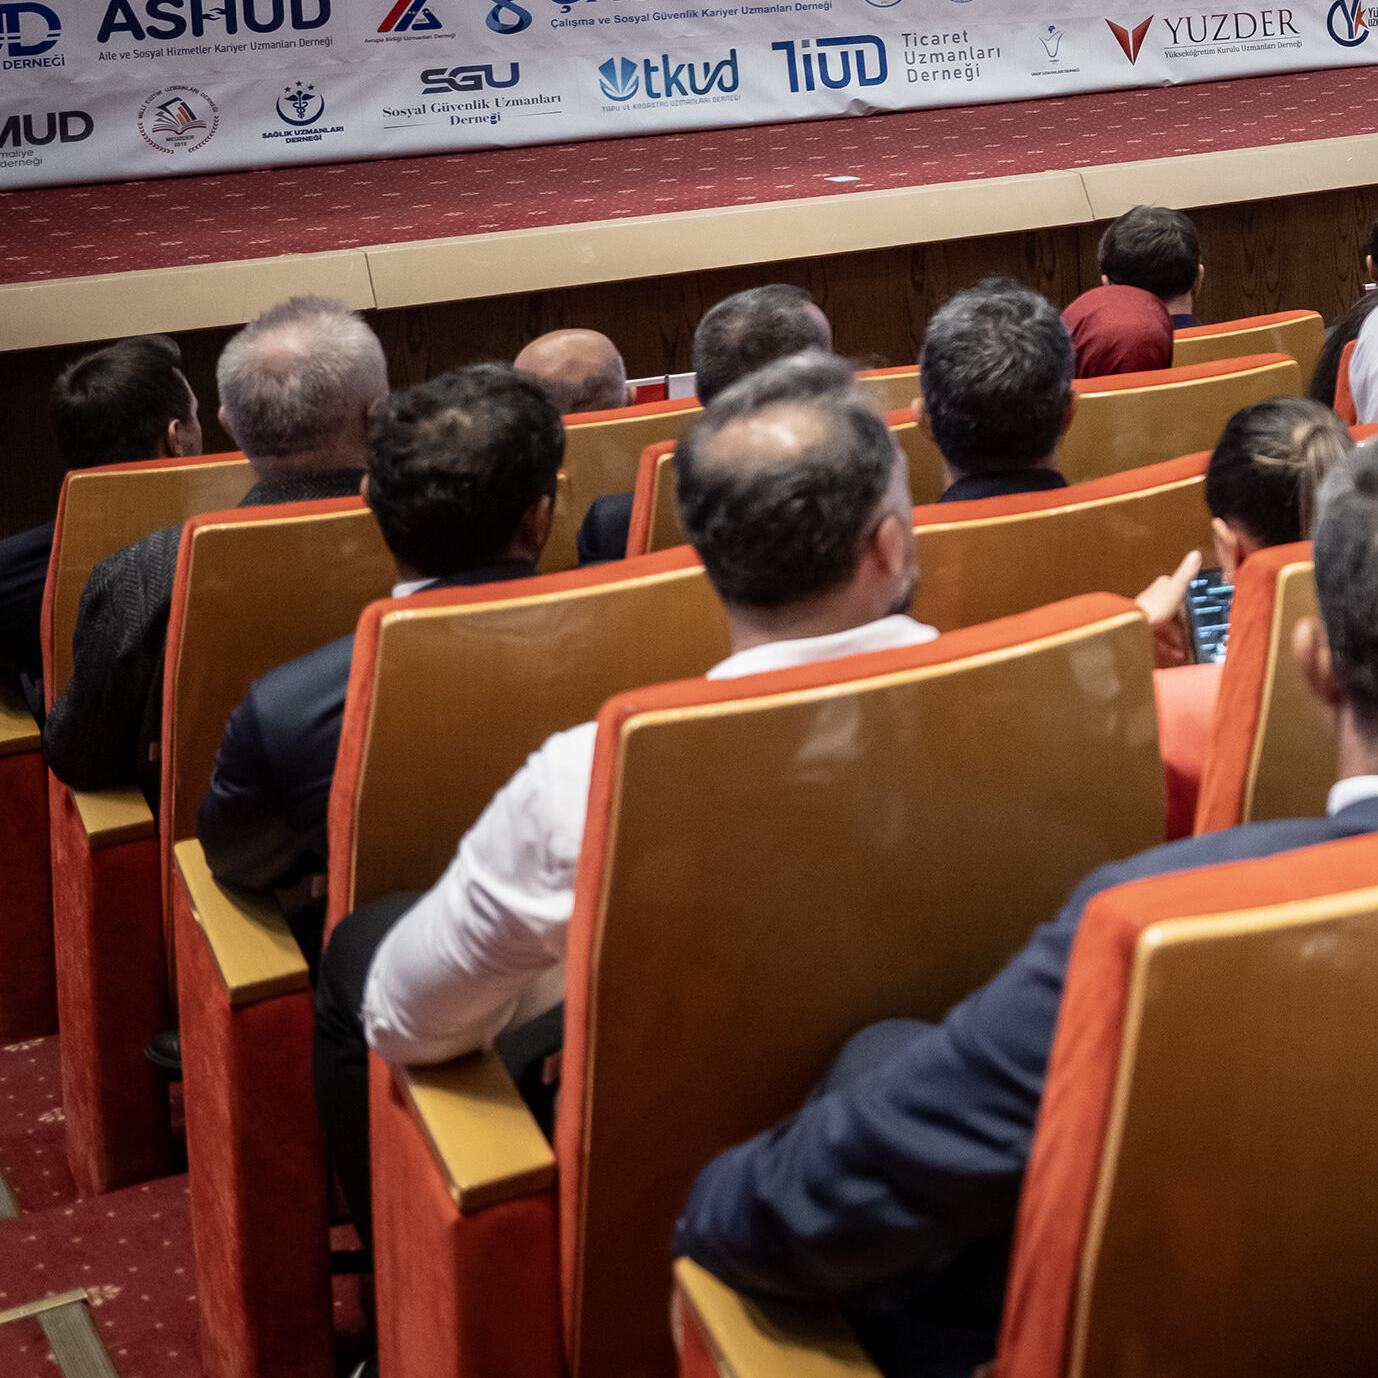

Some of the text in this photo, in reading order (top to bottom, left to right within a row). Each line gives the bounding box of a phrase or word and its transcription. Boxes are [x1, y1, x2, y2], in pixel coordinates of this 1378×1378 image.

[551, 18, 595, 29] Çalışma
[613, 13, 650, 25] Sosyal
[653, 10, 698, 21] Güvenlik
[701, 8, 738, 18] Kariyer
[741, 4, 792, 15] Uzmanları
[795, 1, 832, 11] Derneği
[1163, 9, 1300, 44] YUZDER
[902, 30, 969, 47] Ticaret
[98, 36, 333, 61] Aile ve Sosyal Hizmetler Kariyer Uzmanları Derneği
[904, 47, 1001, 65] Uzmanları
[1164, 41, 1302, 59] Yükseköğretim Kurulu Uzmanları Derneği
[3, 54, 65, 70] DERNEĞİ
[420, 62, 520, 95] SGU
[643, 48, 739, 99] tkud
[907, 63, 980, 83] Derneği
[383, 94, 561, 119] Sosyal Güvenlik Uzmanları
[450, 112, 501, 126] Derneği
[262, 126, 344, 139] SAĞLIK UZMANLARI
[286, 134, 322, 143] DERNEĞİ
